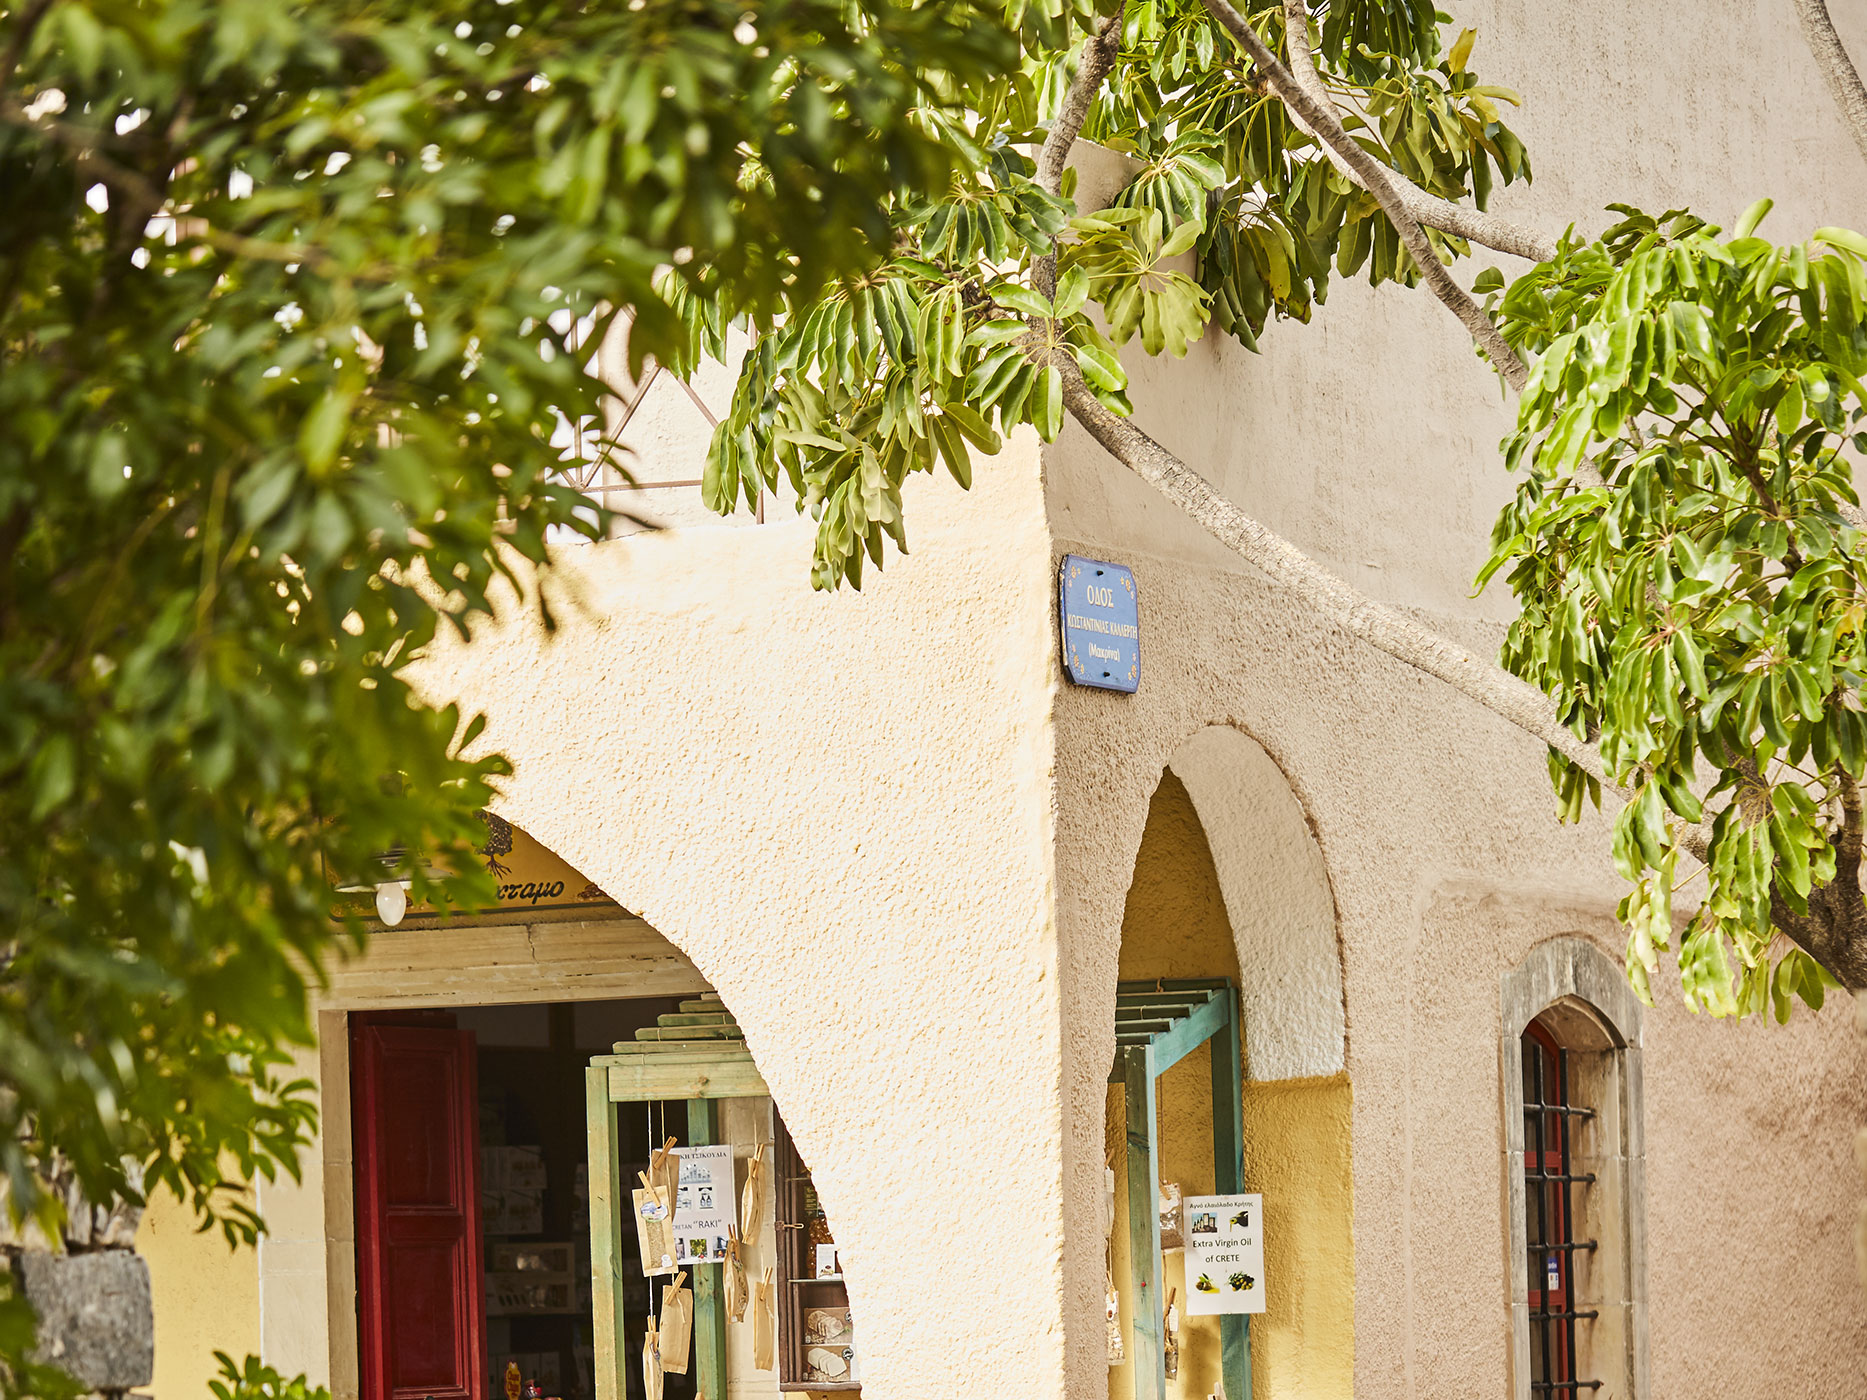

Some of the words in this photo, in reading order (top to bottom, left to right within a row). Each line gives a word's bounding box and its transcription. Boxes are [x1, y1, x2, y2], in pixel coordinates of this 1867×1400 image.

[1087, 584, 1114, 608] ΟΔΟΣ
[1192, 1239, 1214, 1248] Extra
[1215, 1238, 1239, 1249] Virgin
[1240, 1237, 1252, 1246] Oil
[1205, 1254, 1214, 1263] of
[1215, 1254, 1240, 1263] CRETE
